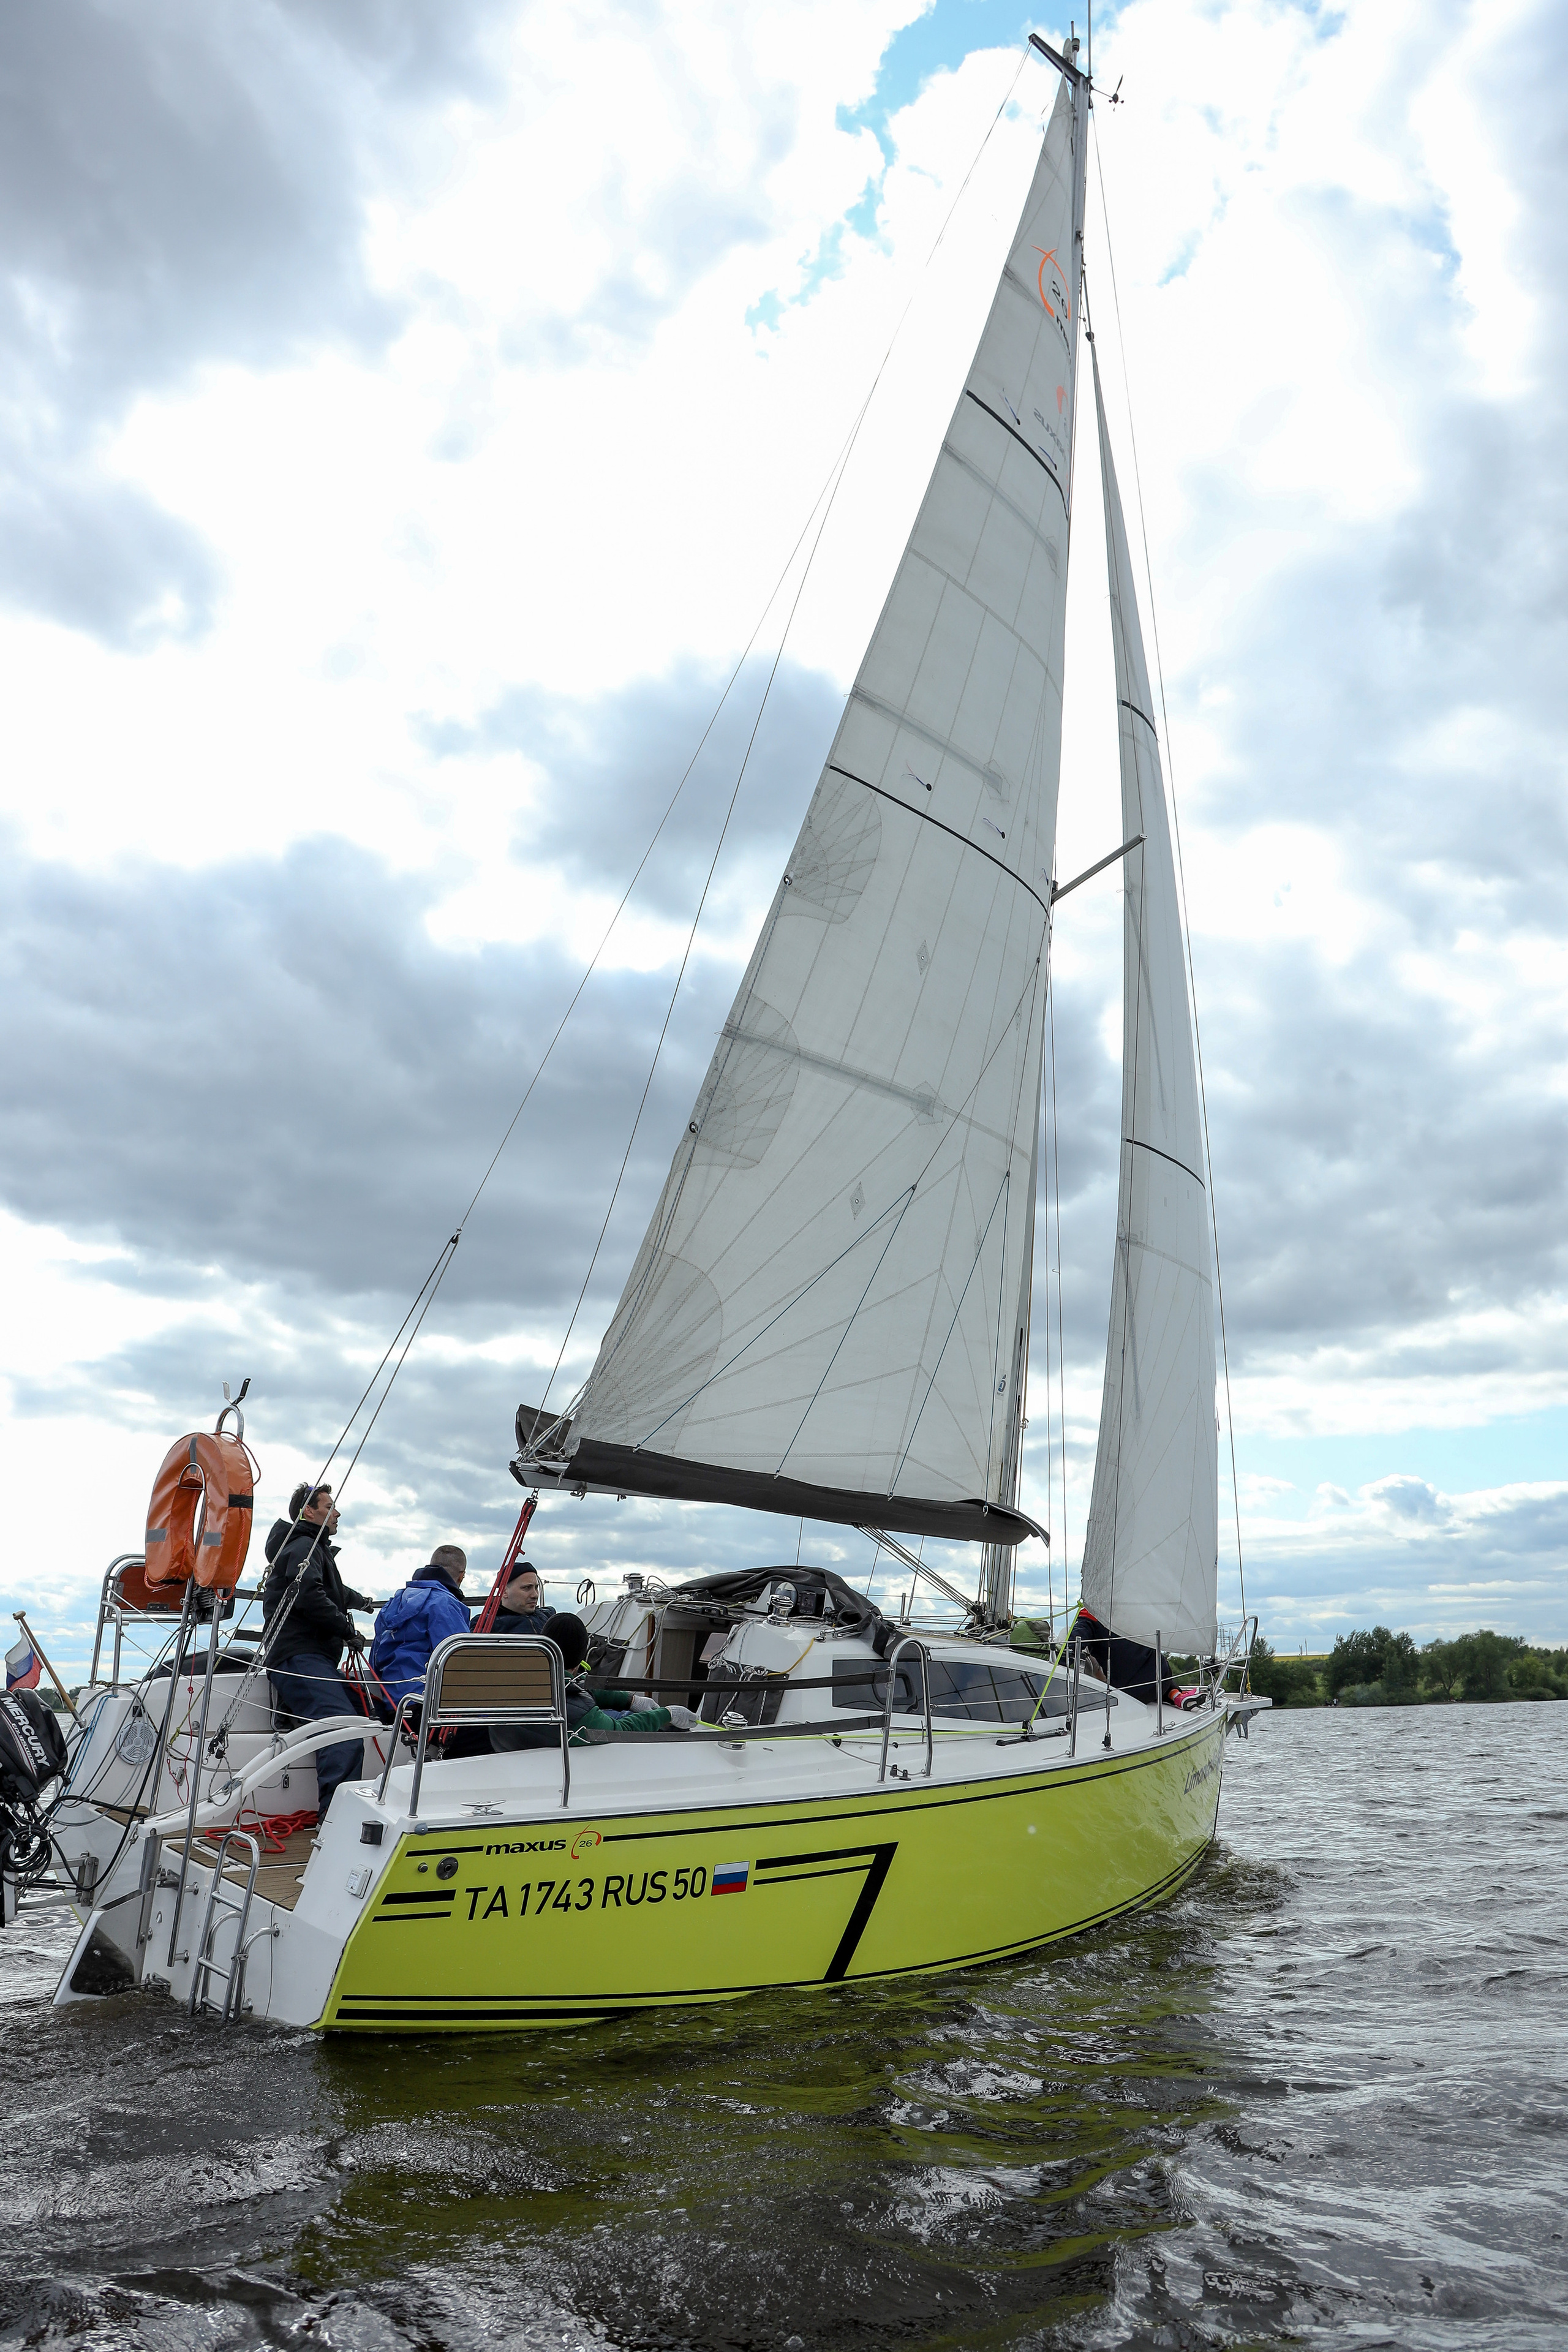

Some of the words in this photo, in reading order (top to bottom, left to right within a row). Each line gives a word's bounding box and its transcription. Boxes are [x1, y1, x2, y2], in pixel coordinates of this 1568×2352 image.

[0, 1696, 50, 1767] MERCURY
[12, 1723, 37, 1770] FOURSTROKE
[486, 1839, 567, 1855] maxus
[465, 1885, 508, 1921] TA
[519, 1877, 595, 1917] 1743
[601, 1871, 668, 1909] RUS
[673, 1866, 707, 1901] 50
